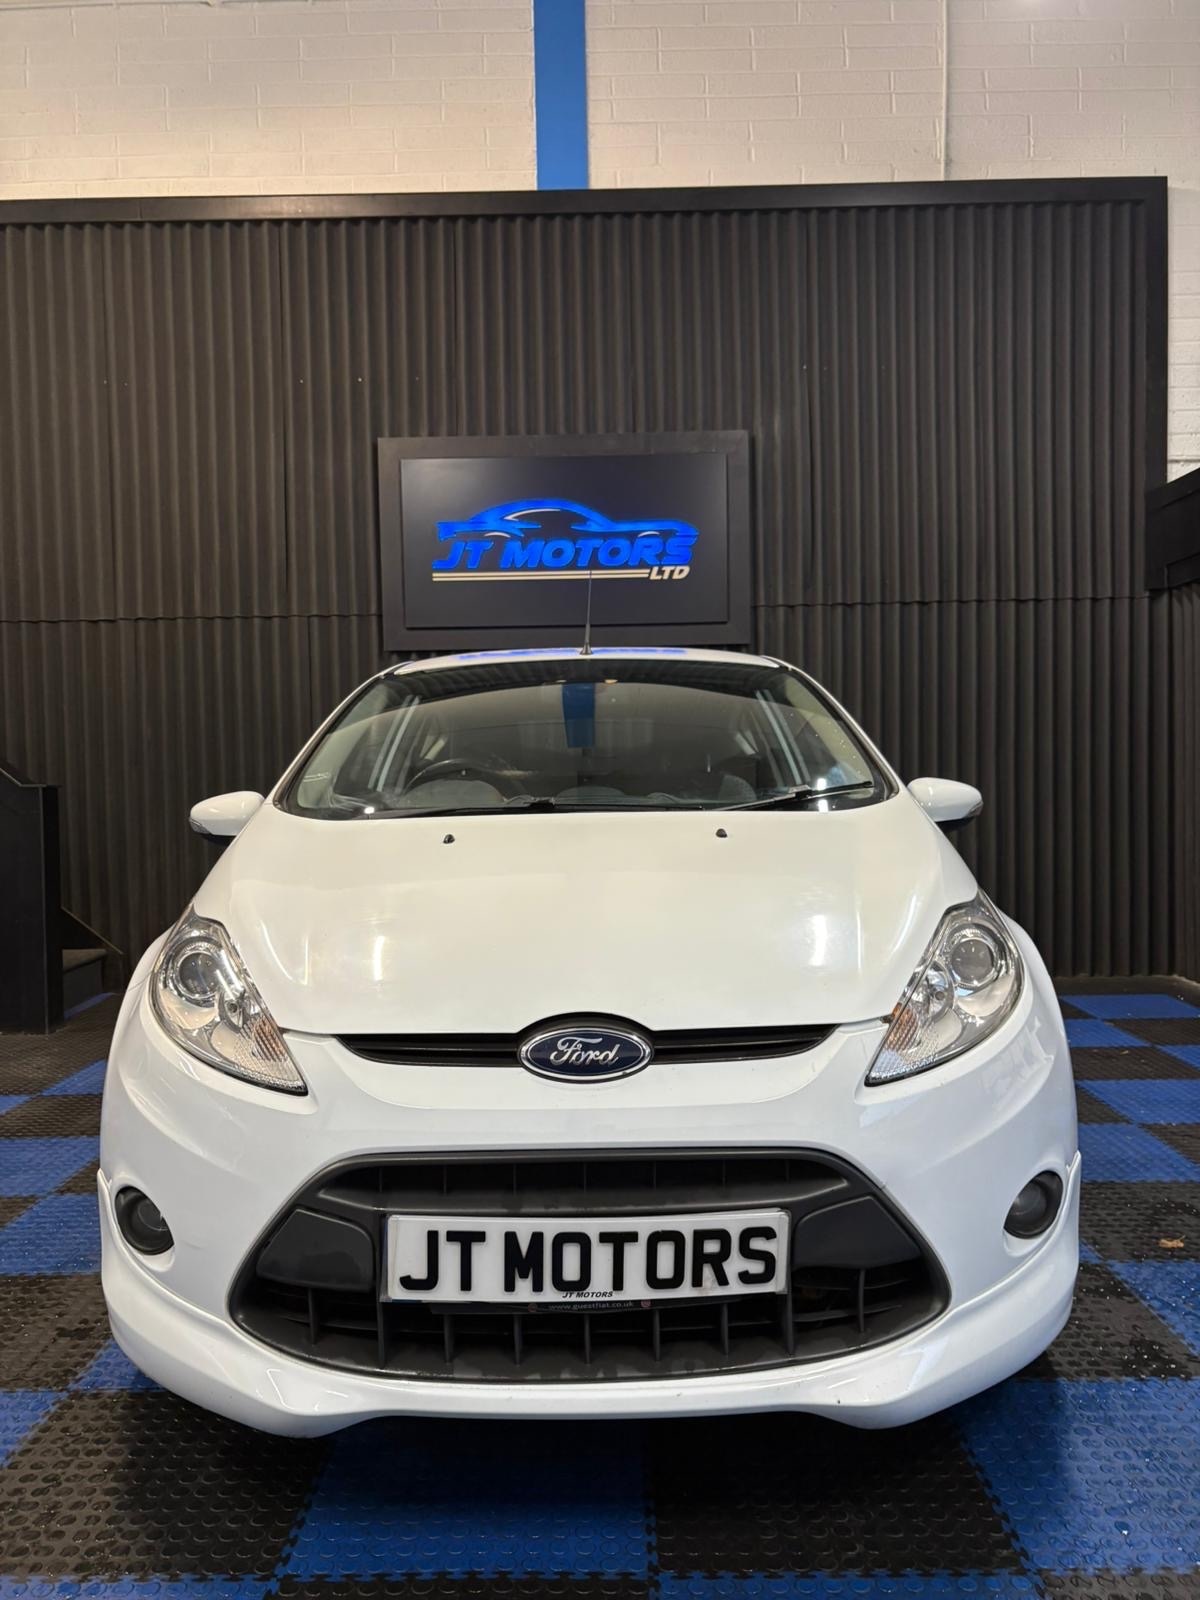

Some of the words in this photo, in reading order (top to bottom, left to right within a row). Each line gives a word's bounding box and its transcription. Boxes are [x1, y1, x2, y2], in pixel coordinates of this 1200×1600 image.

[432, 540, 494, 569] JT
[500, 536, 699, 569] MOTORS
[649, 565, 690, 580] LTD
[549, 1036, 621, 1066] Ford
[399, 1230, 486, 1292] JT
[504, 1226, 777, 1292] MOTORS
